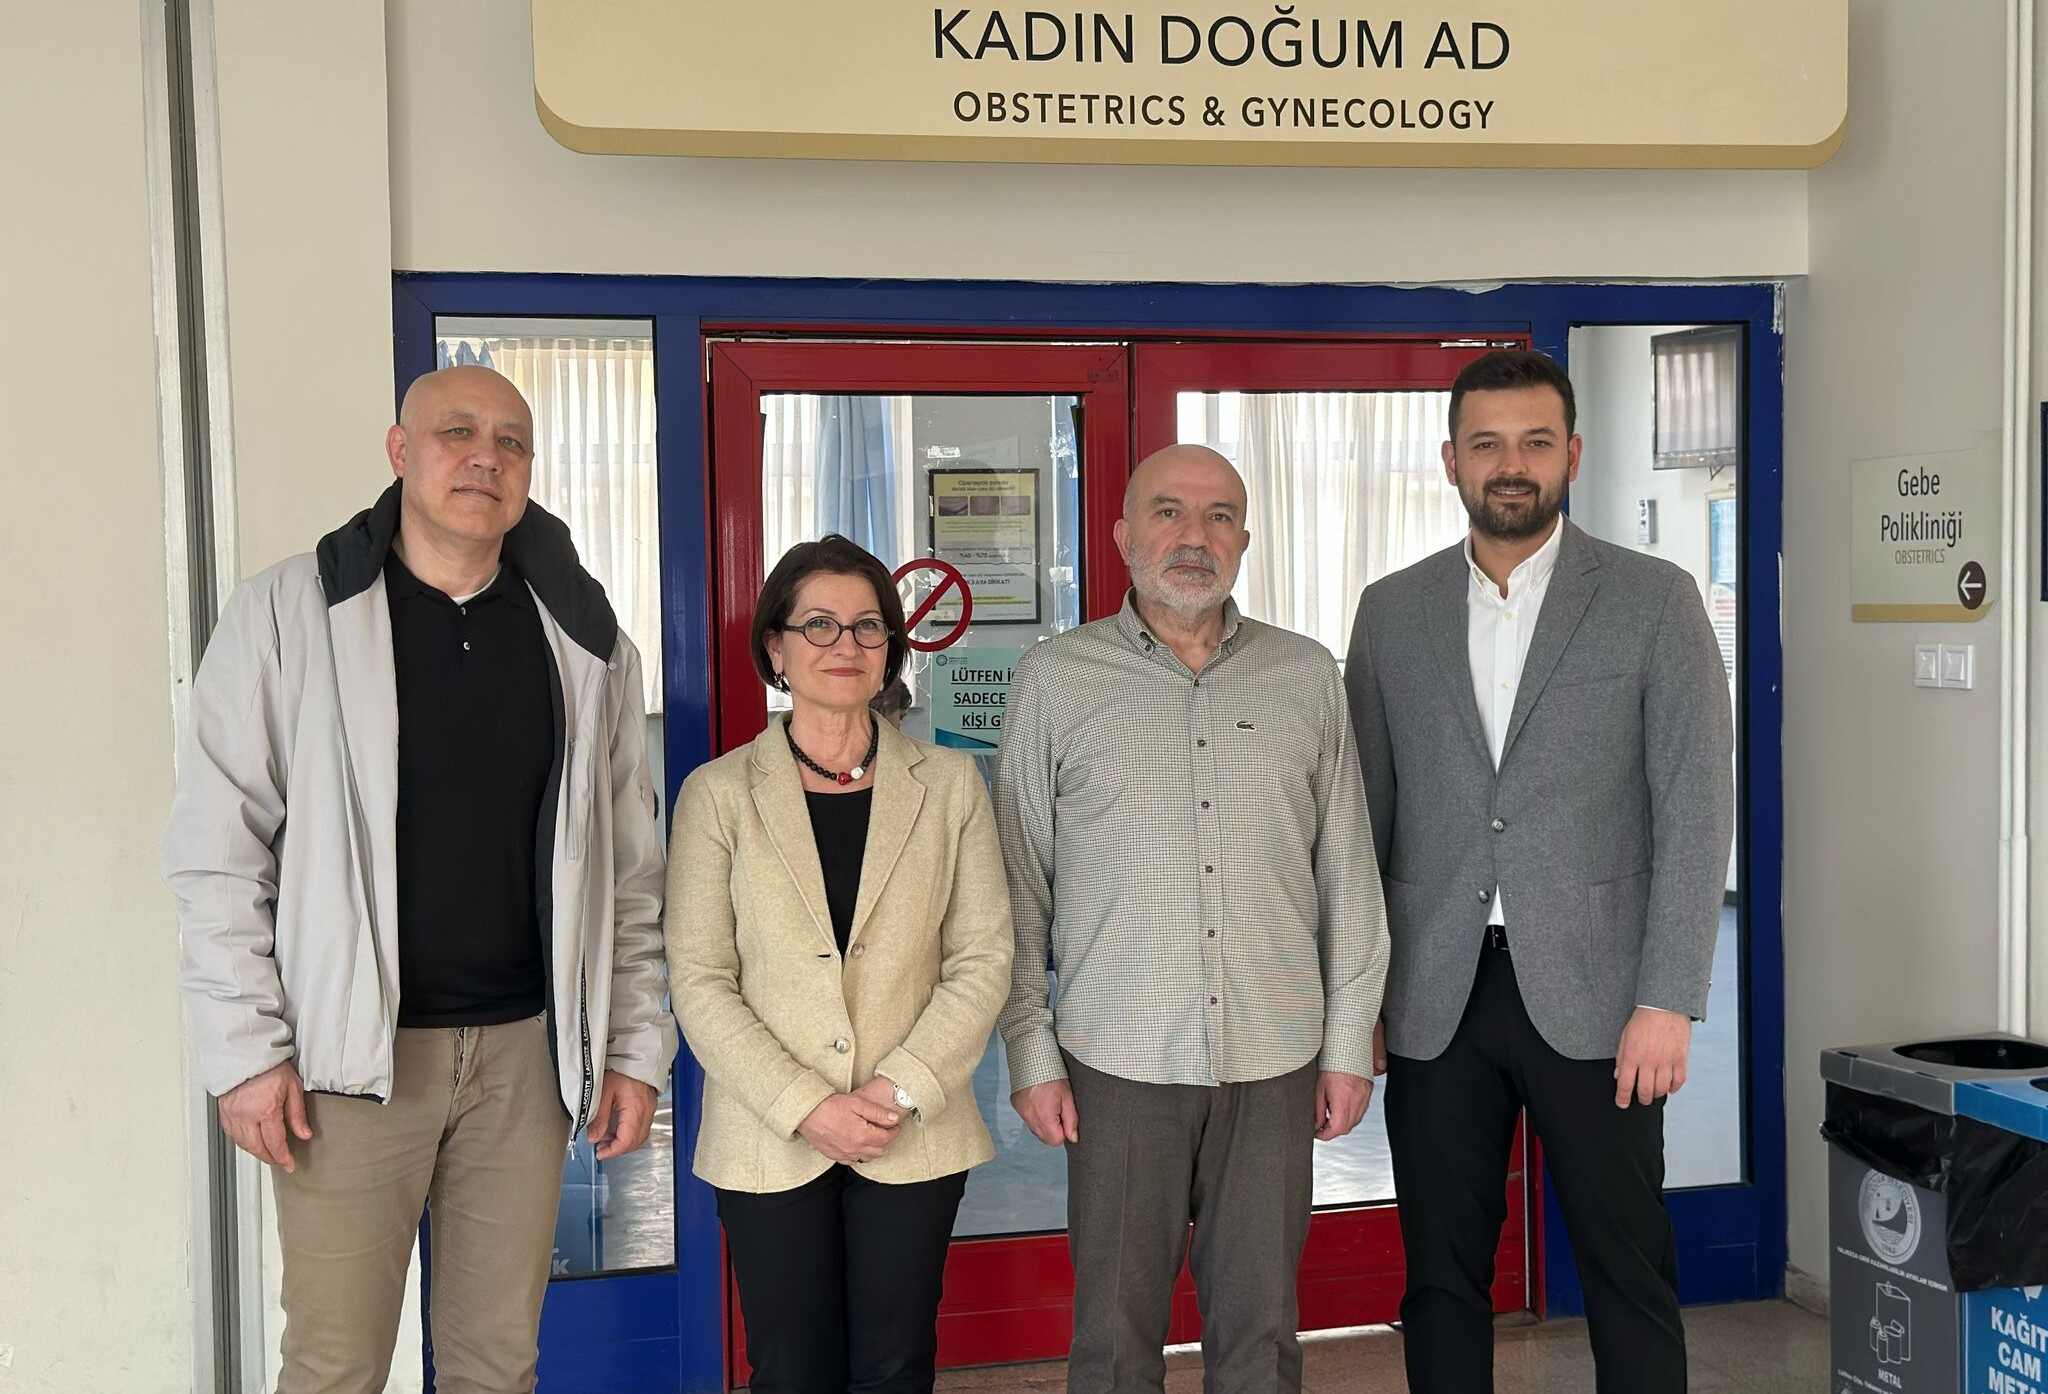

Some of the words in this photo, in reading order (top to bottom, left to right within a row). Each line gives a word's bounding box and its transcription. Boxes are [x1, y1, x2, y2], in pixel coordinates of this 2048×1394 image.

[934, 8, 1134, 64] KADIN
[1160, 4, 1403, 69] DOĞUM
[1423, 21, 1510, 70] AD
[953, 90, 1186, 126] OBSTETRICS
[1202, 95, 1226, 127] &
[1241, 96, 1495, 130] GYNECOLOGY
[1897, 466, 1940, 497] Gebe
[1881, 511, 1962, 548] Polikliniği
[1894, 548, 1945, 565] OBSTETRICS
[951, 667, 1003, 683] LÜTFEN
[1007, 667, 1015, 683] İ
[953, 692, 1006, 705] SADECE
[962, 712, 987, 728] KİŞİ
[990, 712, 1004, 727] G
[1990, 1305, 2048, 1353] KAĞIT
[1998, 1341, 2041, 1383] CAM
[1877, 1368, 1902, 1390] METAL
[1988, 1366, 2046, 1394] MET
